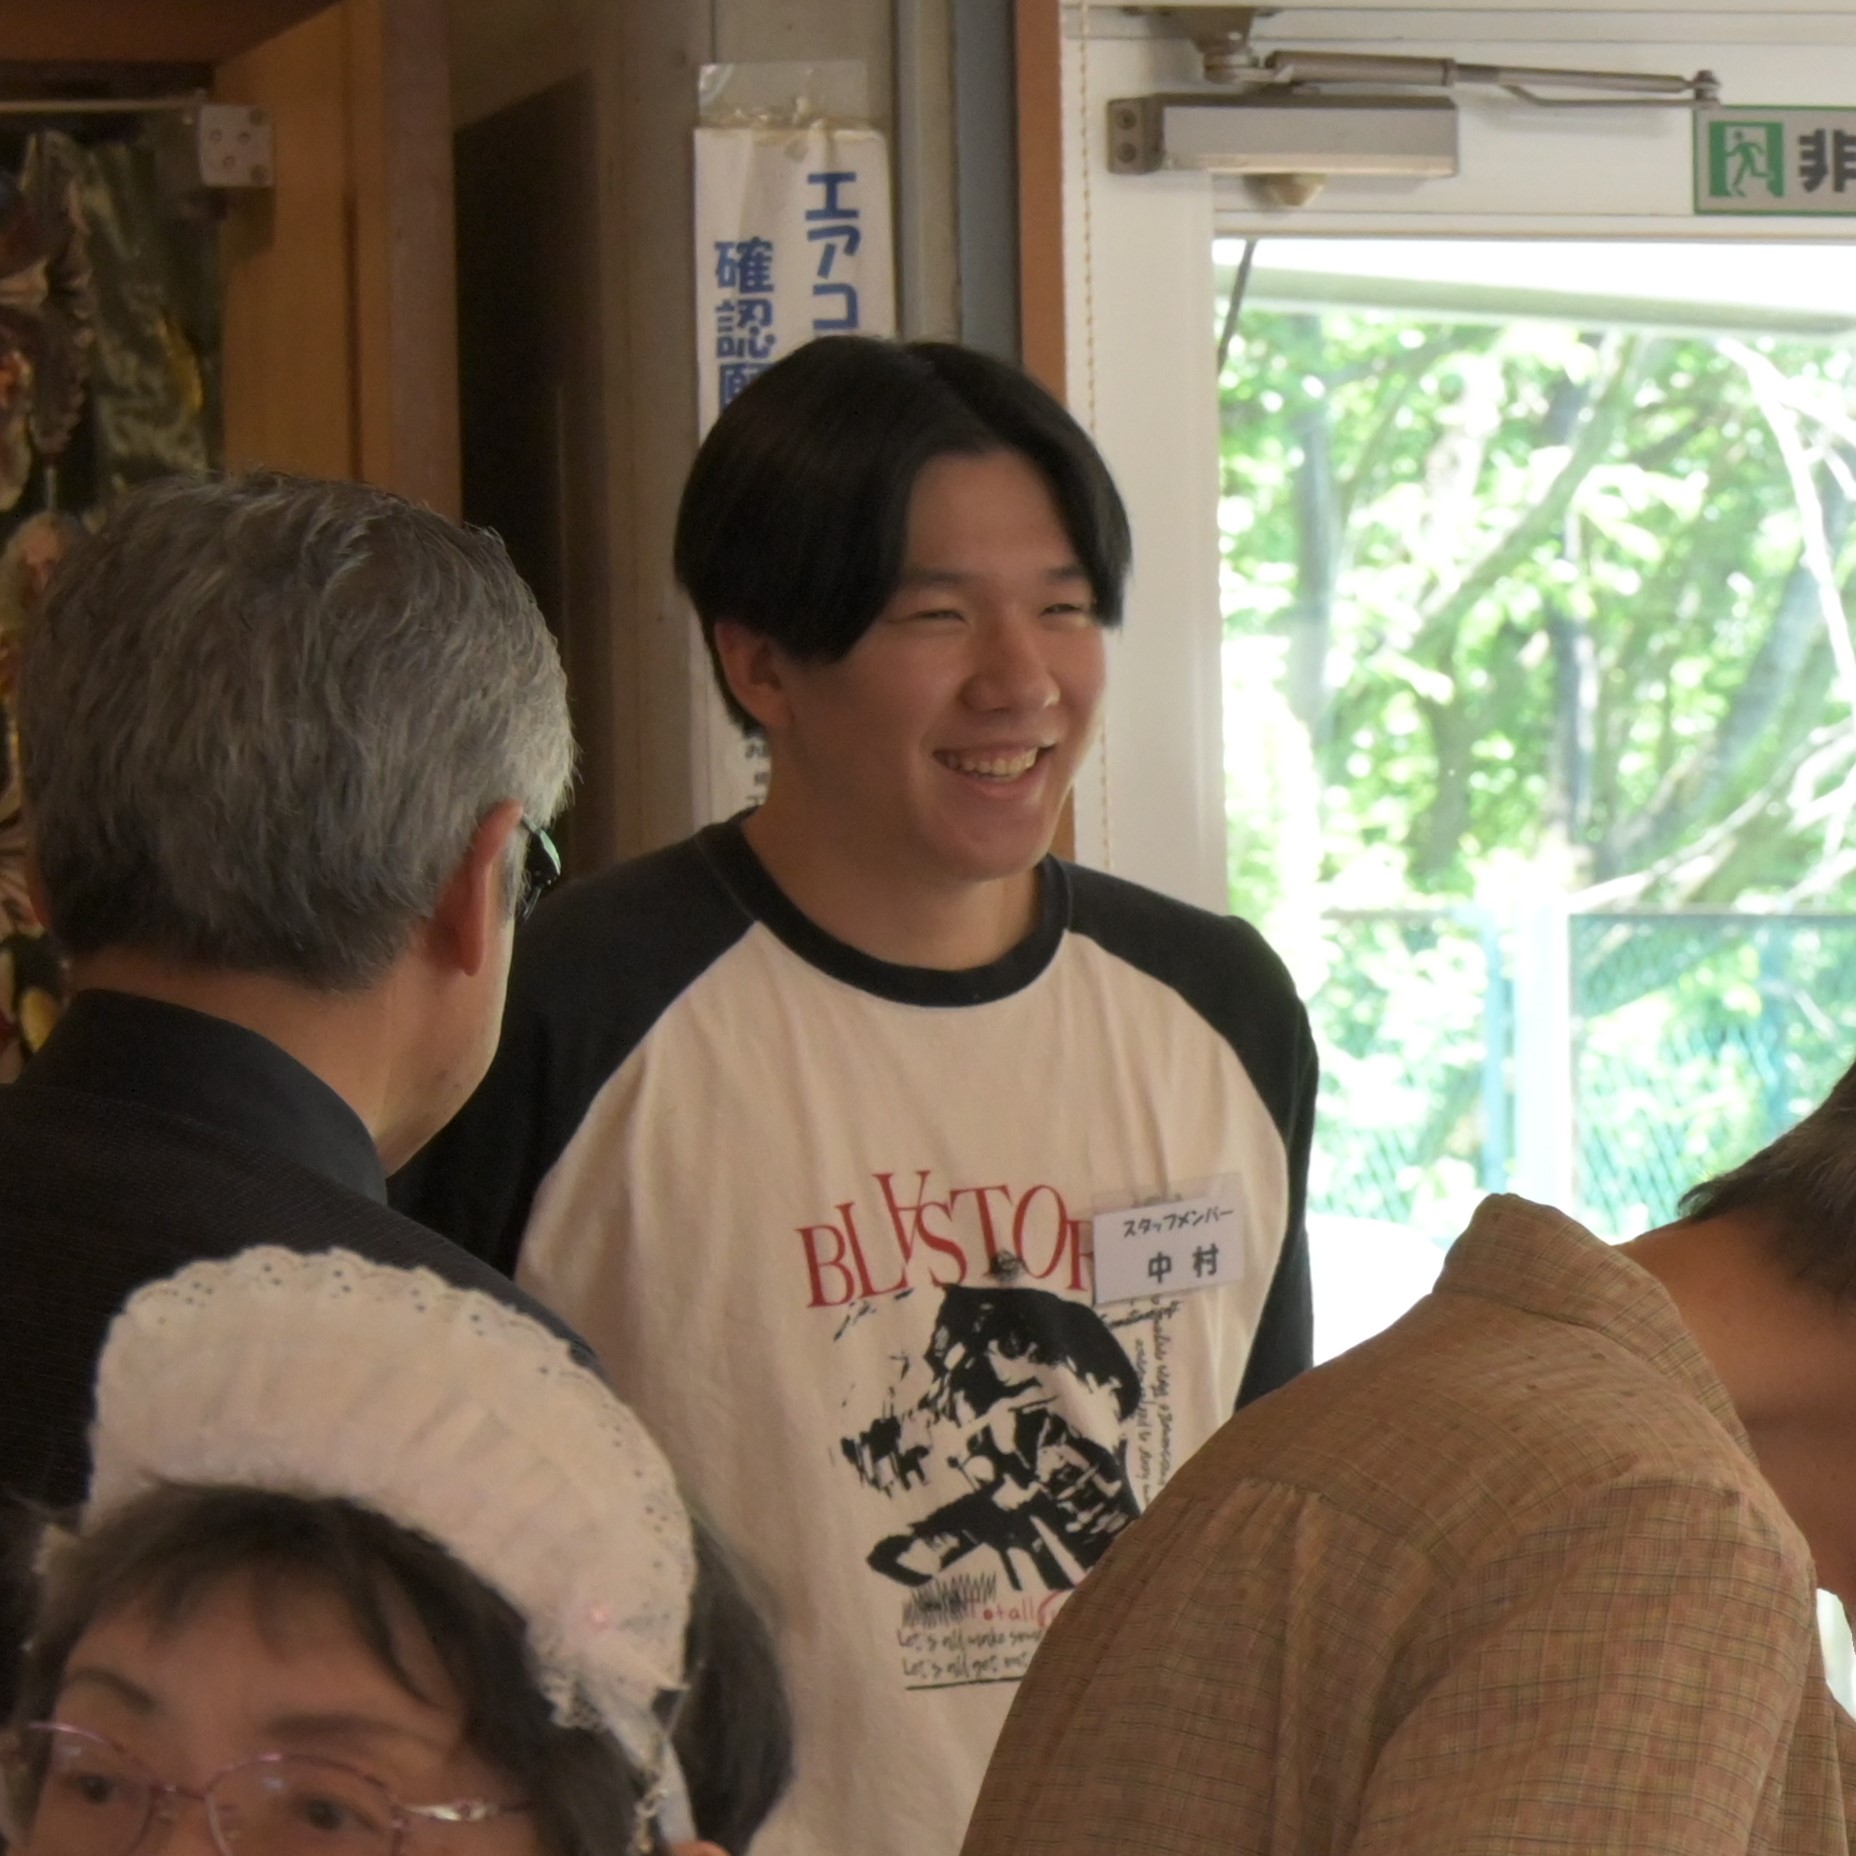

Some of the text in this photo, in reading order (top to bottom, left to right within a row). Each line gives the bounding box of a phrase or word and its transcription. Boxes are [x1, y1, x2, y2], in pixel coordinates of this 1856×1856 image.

[1123, 1206, 1235, 1238] スタッフメンバー
[1148, 1243, 1220, 1285] 中村
